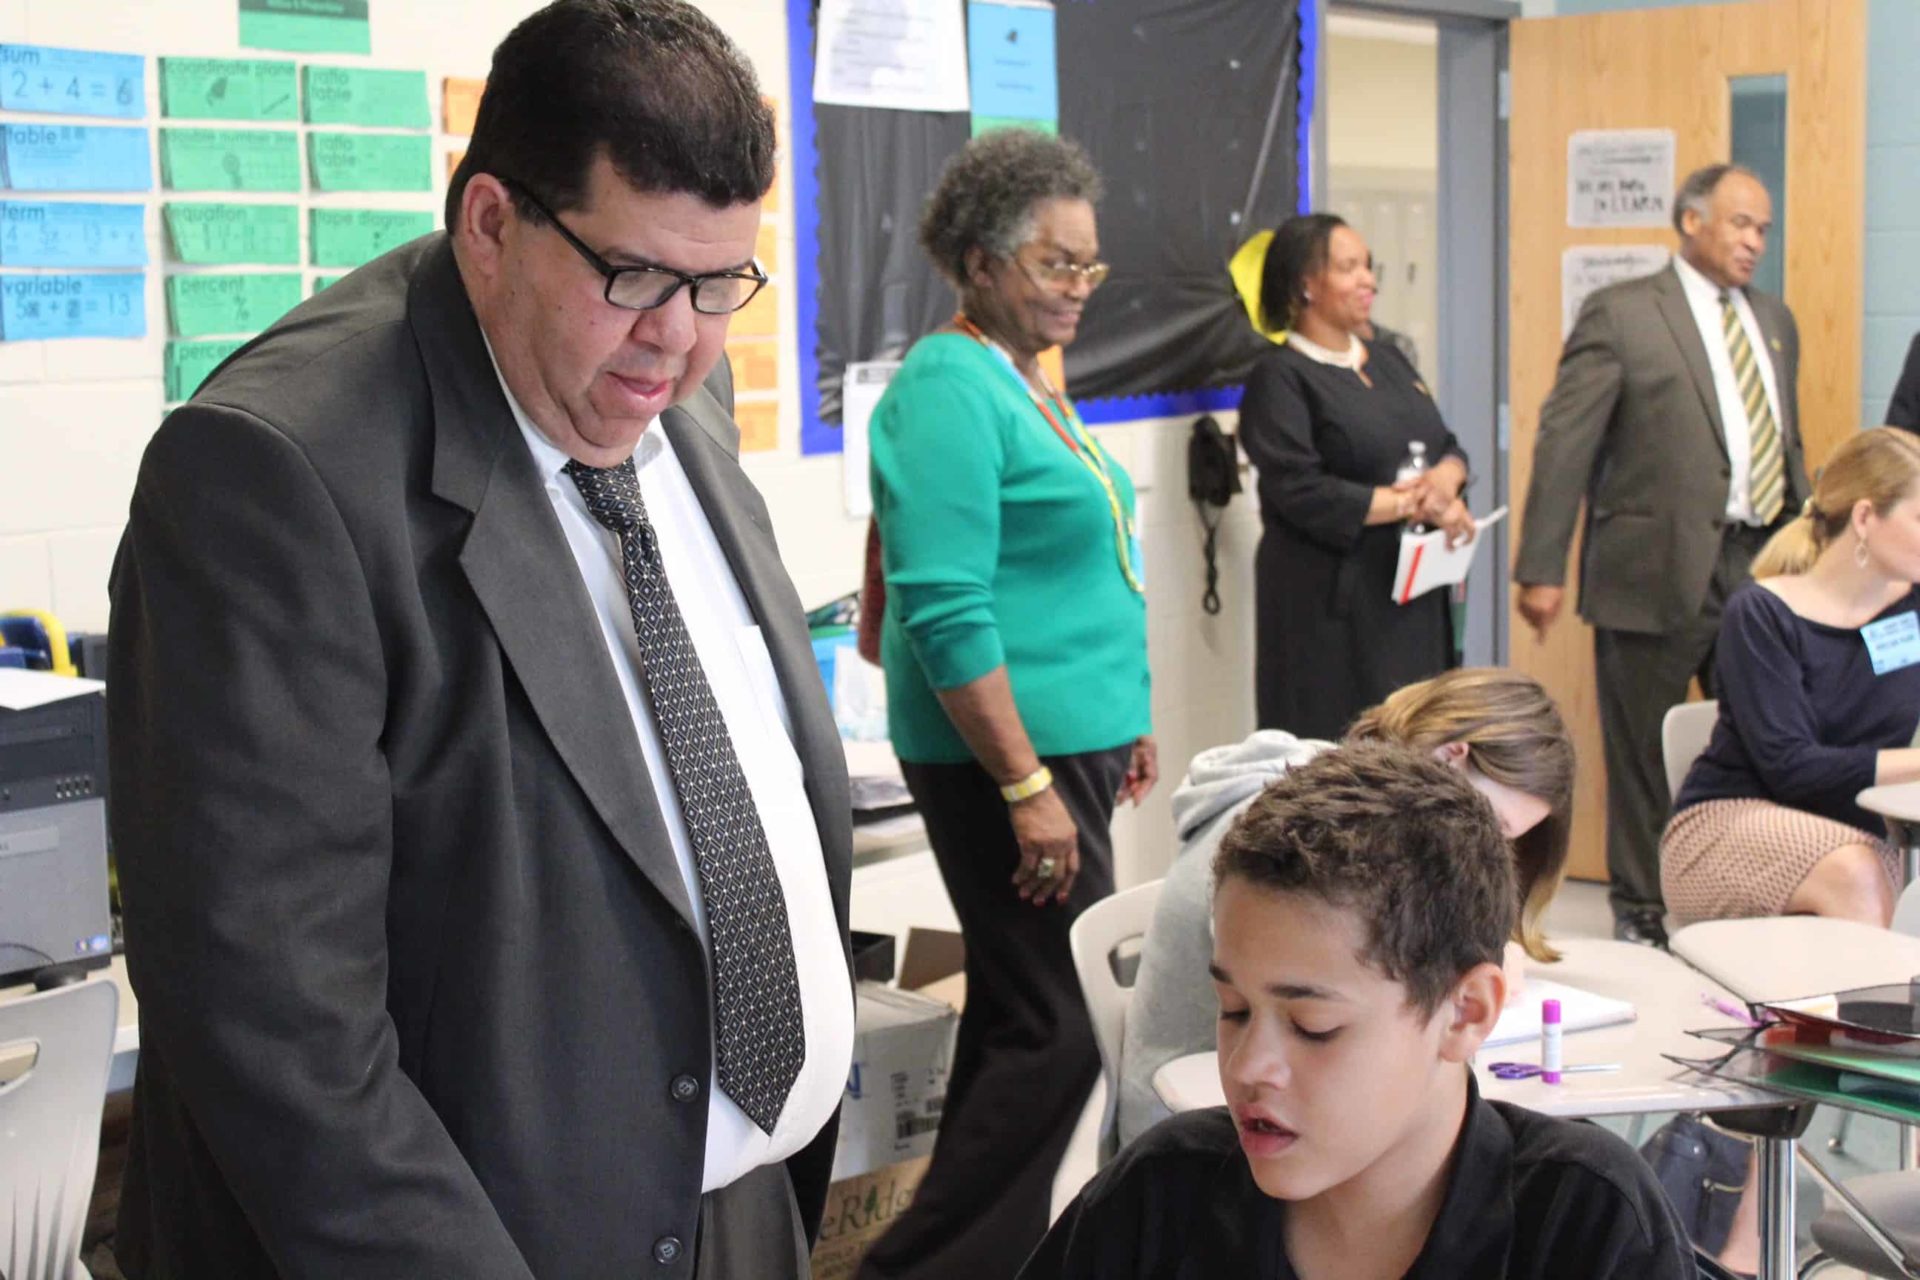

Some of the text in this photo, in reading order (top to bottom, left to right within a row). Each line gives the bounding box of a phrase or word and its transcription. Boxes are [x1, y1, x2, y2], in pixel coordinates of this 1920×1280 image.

[11, 69, 28, 98] 2
[5, 276, 82, 299] variable
[181, 277, 245, 296] percent
